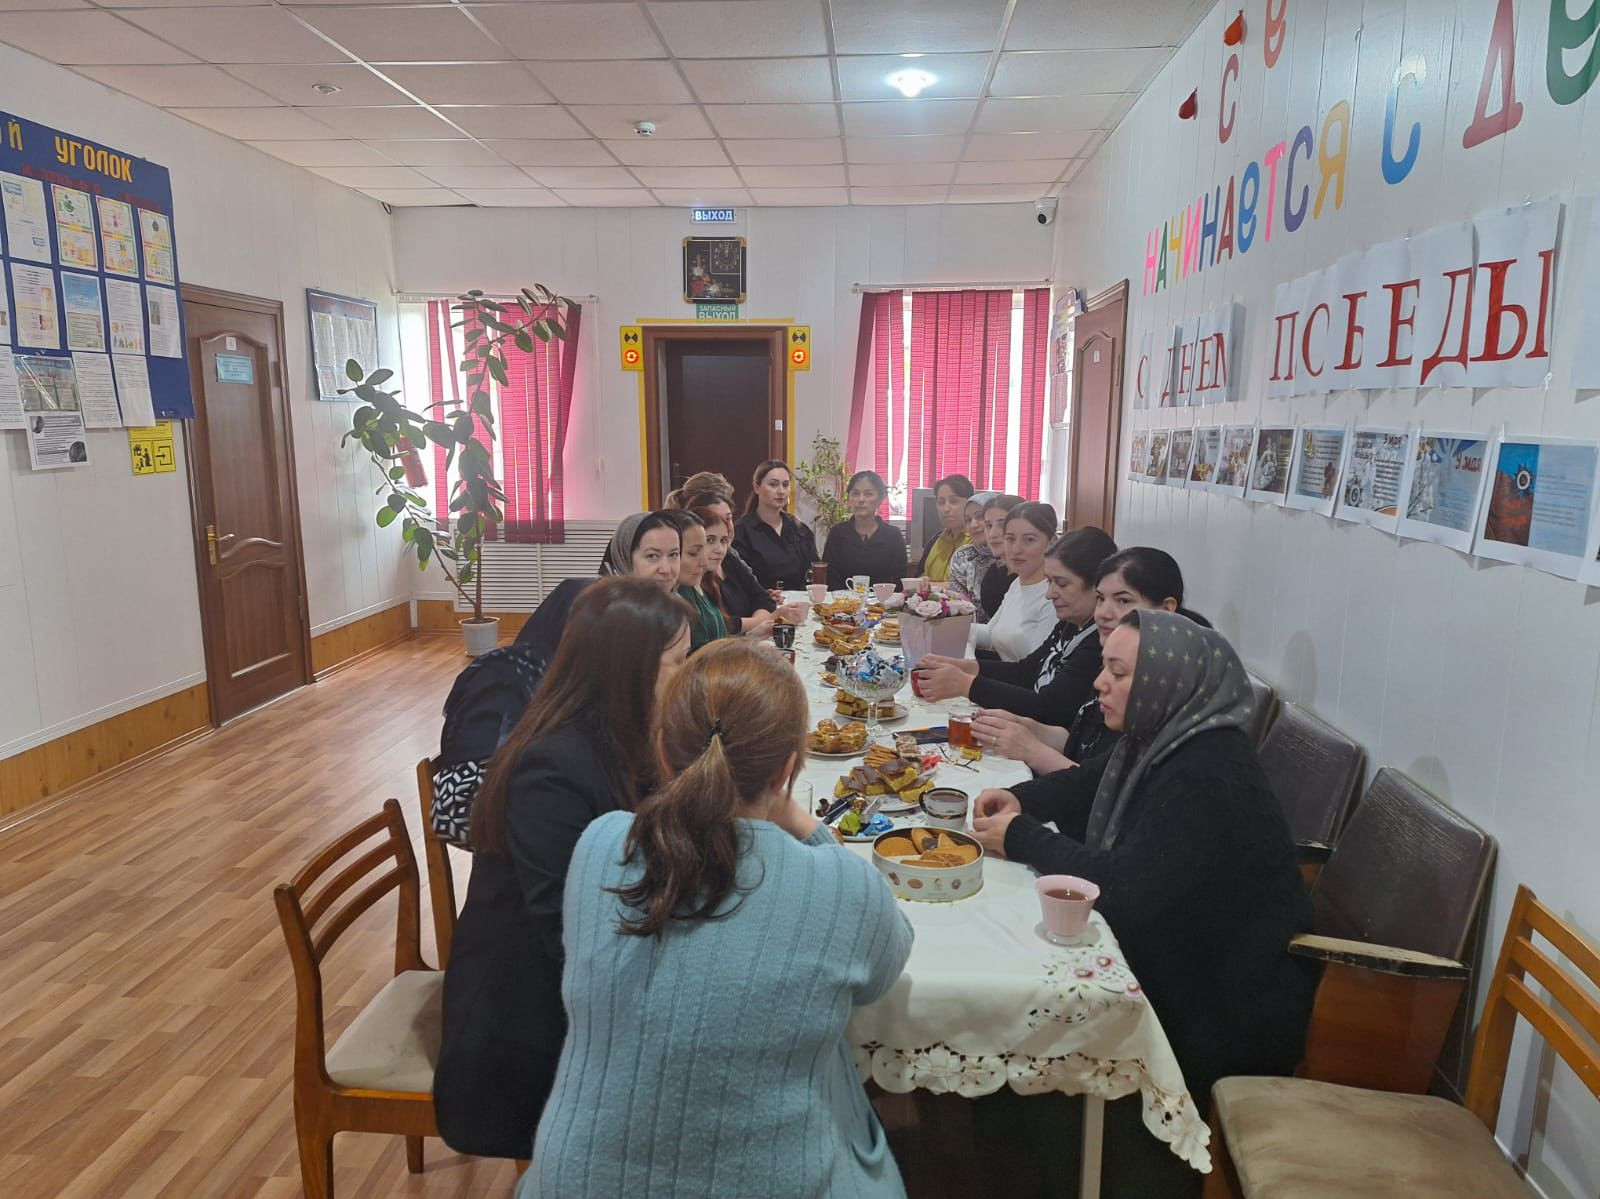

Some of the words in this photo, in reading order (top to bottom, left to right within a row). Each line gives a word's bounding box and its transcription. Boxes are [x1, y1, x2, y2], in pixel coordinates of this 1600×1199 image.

[1381, 54, 1427, 185] С
[54, 135, 133, 184] УГОЛОК
[694, 210, 733, 221] ВЫХОД
[699, 312, 736, 320] ВЫХОД
[1137, 354, 1148, 400] С
